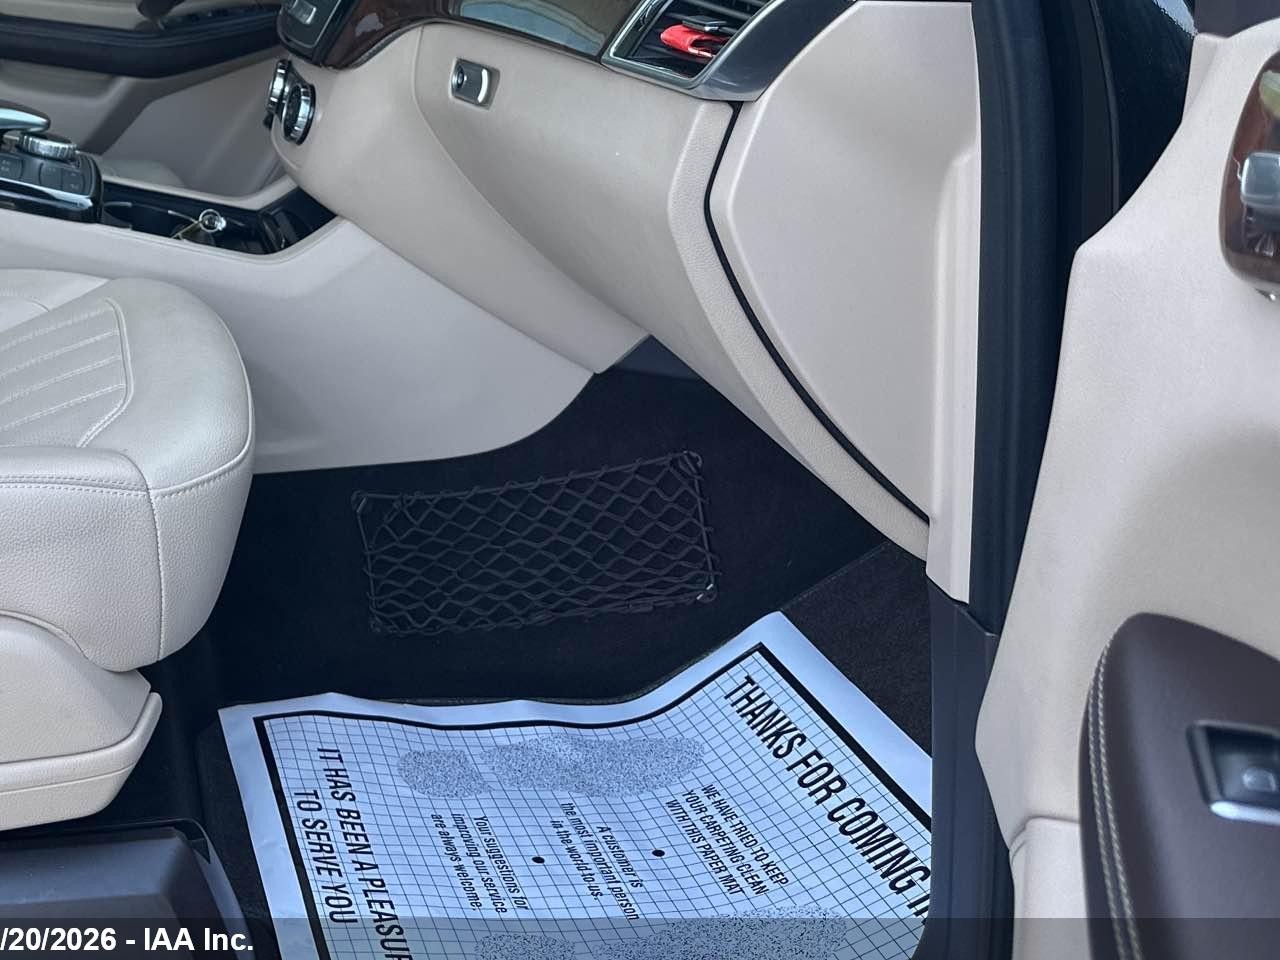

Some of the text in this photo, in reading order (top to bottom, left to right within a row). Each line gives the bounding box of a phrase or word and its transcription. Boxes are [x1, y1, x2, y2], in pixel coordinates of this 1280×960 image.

[317, 748, 343, 763] IT
[323, 768, 356, 802] HAS
[724, 675, 807, 759] THANKS
[786, 750, 847, 805] FOR
[827, 798, 931, 895] COMING
[336, 807, 374, 855] BEEN
[431, 814, 446, 829] are
[439, 831, 462, 863] always
[550, 820, 563, 829] in
[556, 830, 572, 845] the
[665, 800, 745, 895] WITH THIS PAPER MAT
[682, 790, 769, 895] YOUR CARPETING CLEAN
[701, 784, 789, 885] WE HAVE TRIED TO KEEP
[294, 790, 358, 923] TO SERVE YOU
[352, 860, 379, 872] A
[451, 813, 507, 913] improving our service
[473, 815, 529, 910] Your suggestions for
[561, 802, 640, 920] the most important person
[565, 846, 592, 871] world
[581, 873, 595, 883] to
[602, 834, 637, 877] customer
[629, 879, 643, 888] is
